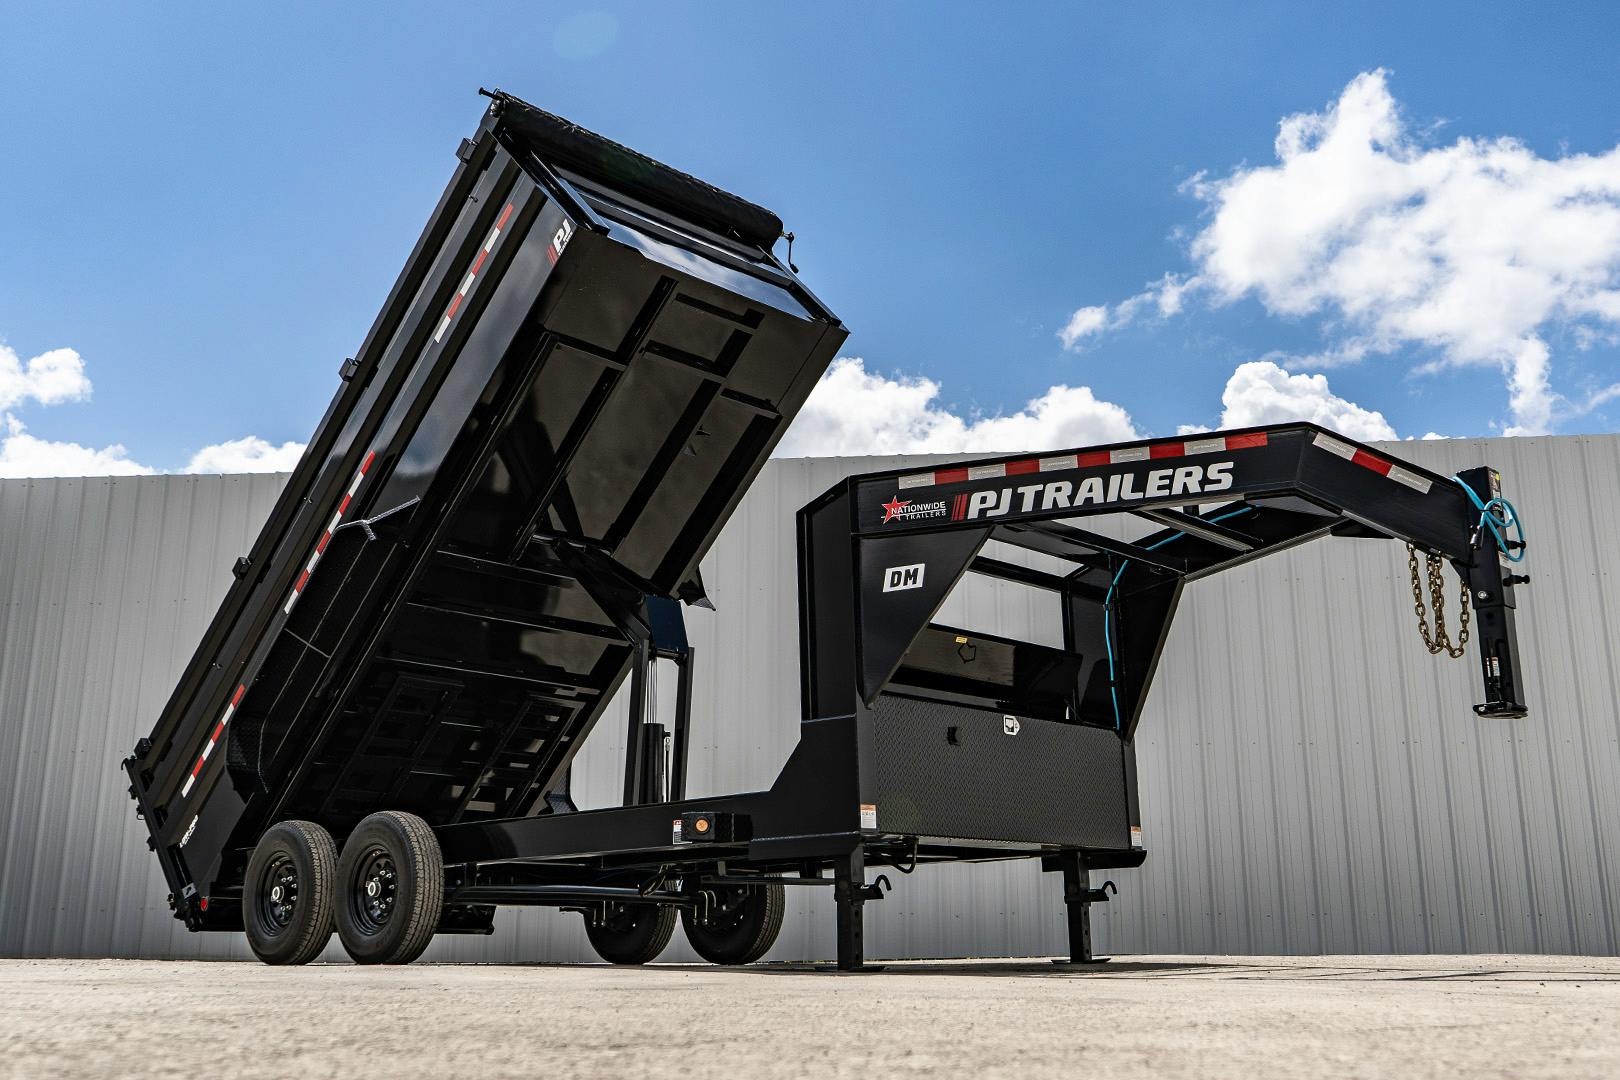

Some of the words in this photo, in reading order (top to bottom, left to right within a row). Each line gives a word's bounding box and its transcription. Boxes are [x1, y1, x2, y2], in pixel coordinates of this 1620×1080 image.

[553, 218, 571, 253] PJ
[967, 488, 1013, 520] PJ
[1017, 461, 1234, 513] TRAILERS
[891, 501, 946, 515] NATIONWIDE
[905, 509, 947, 521] TRAILERS
[890, 567, 919, 588] DM
